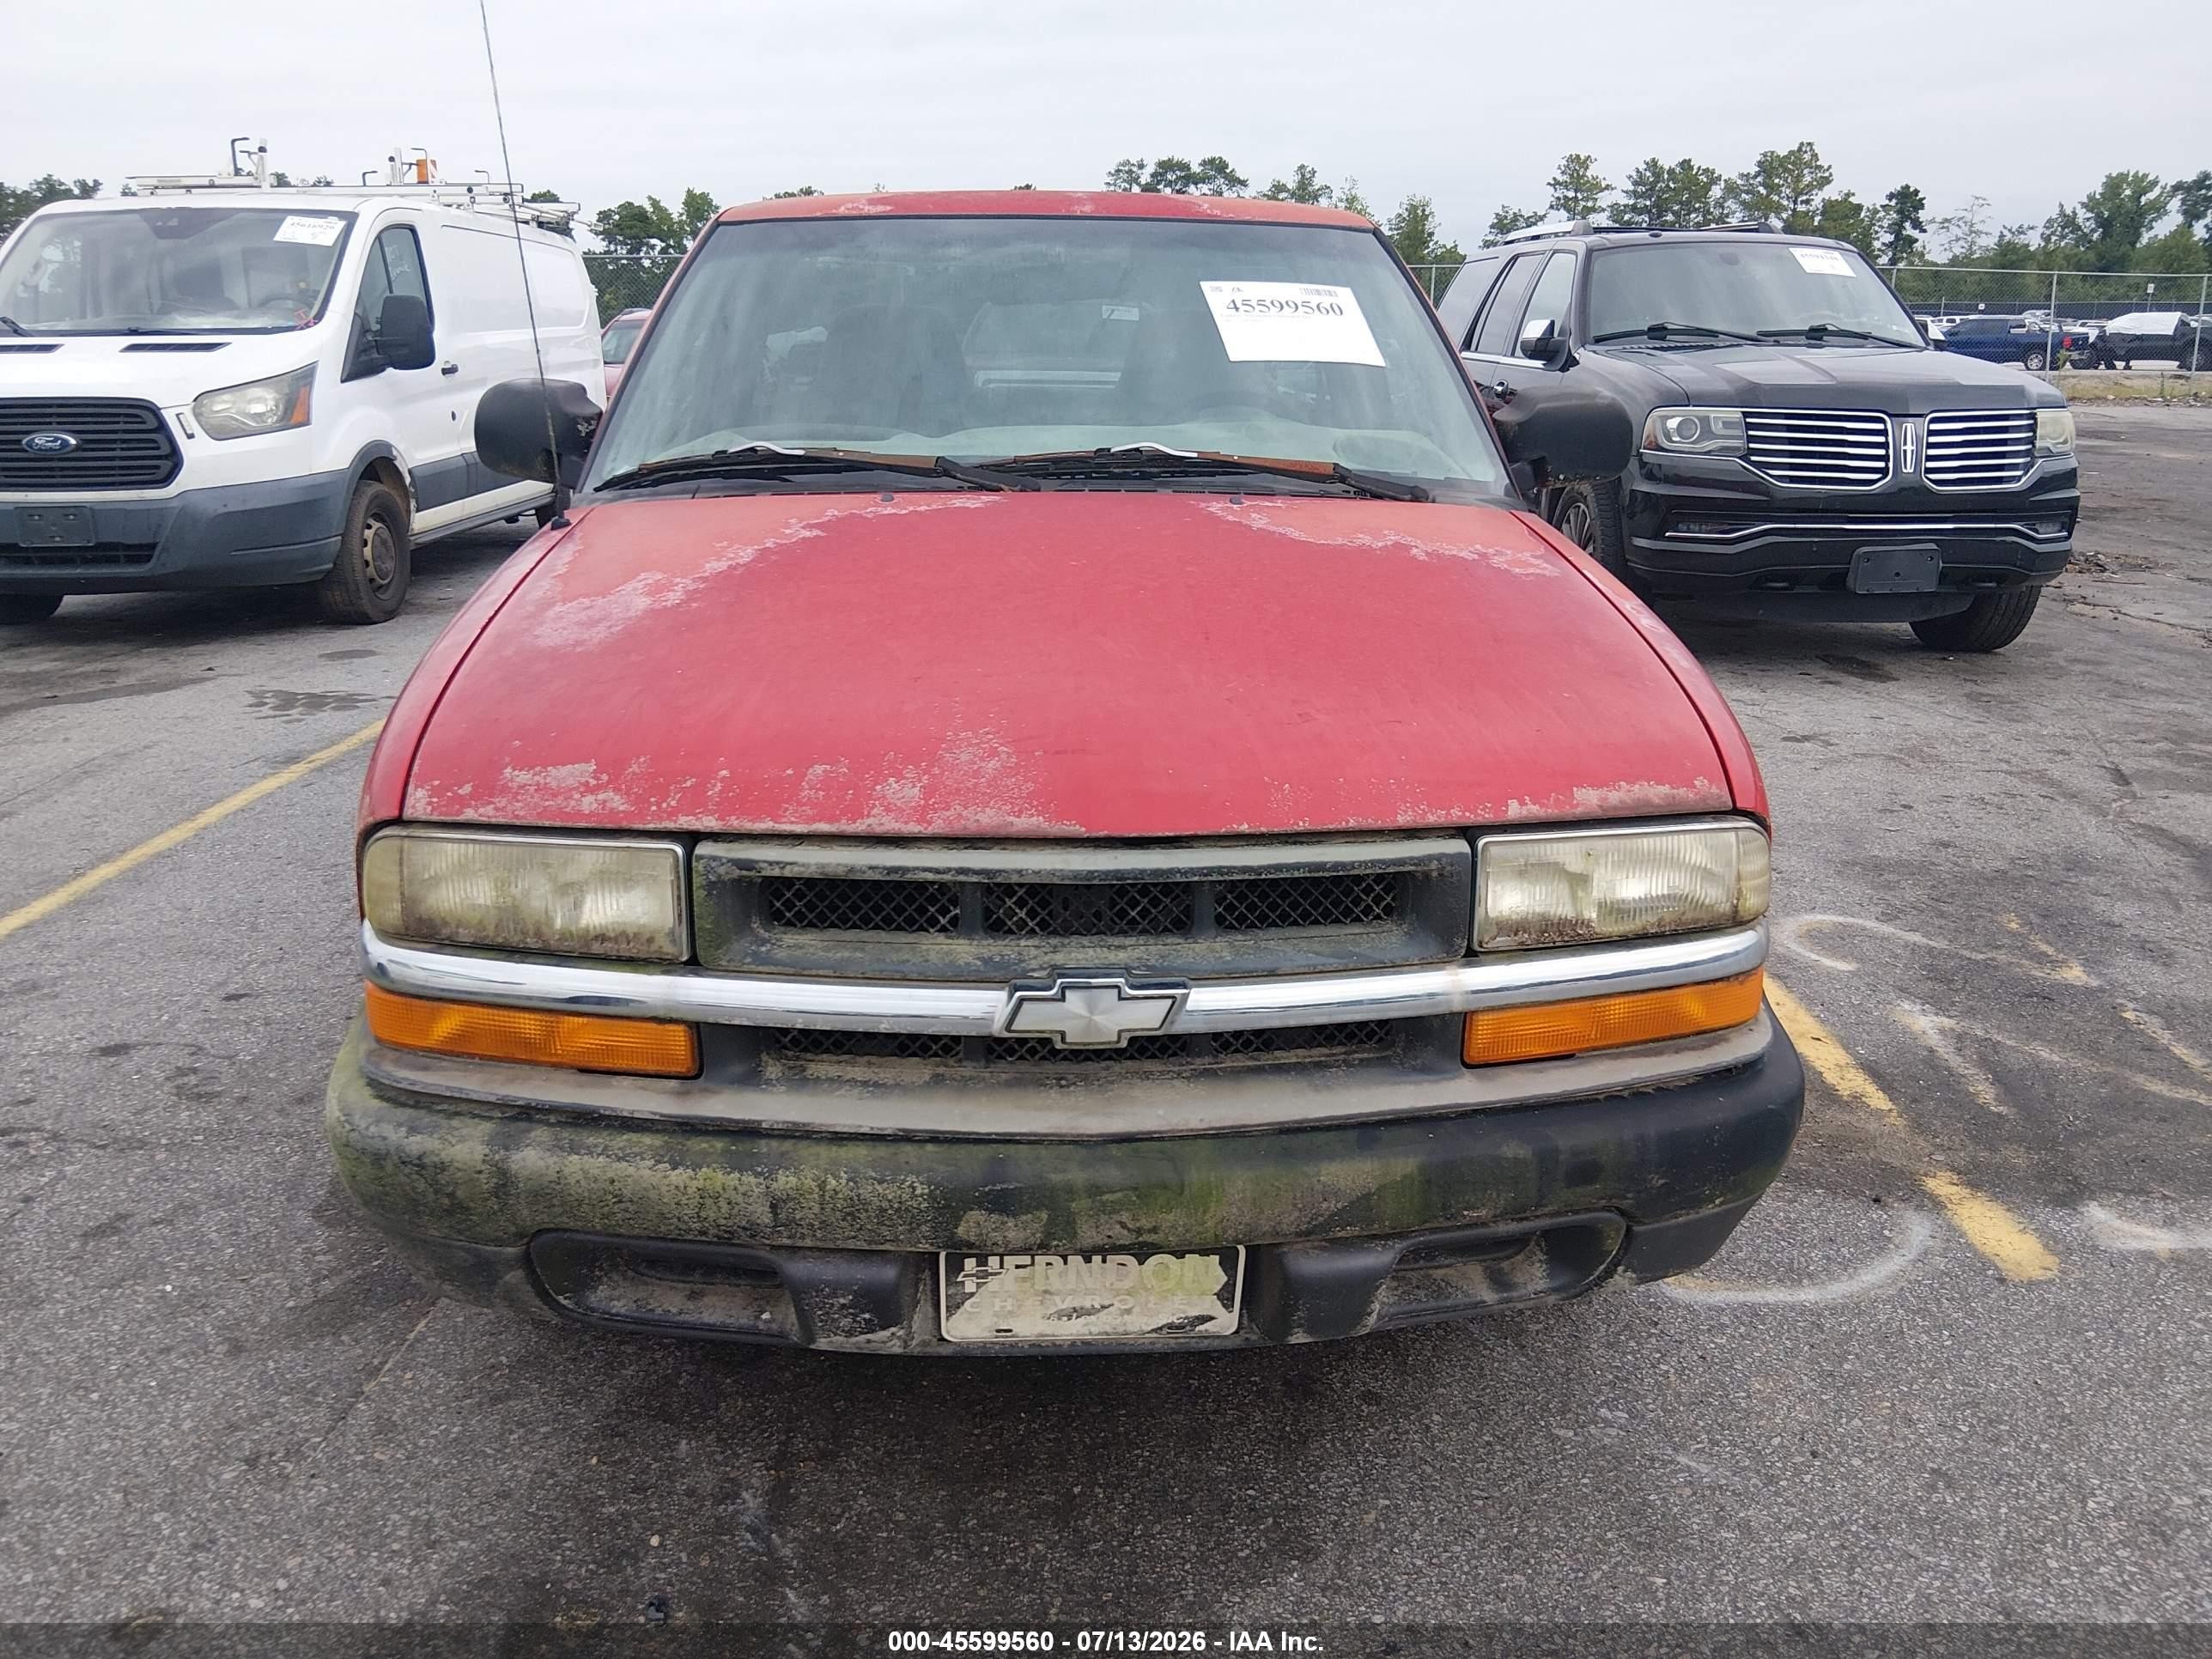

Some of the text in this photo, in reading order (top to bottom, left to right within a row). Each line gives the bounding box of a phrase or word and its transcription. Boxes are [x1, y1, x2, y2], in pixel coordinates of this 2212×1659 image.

[1226, 298, 1343, 316] 45599560
[33, 436, 62, 449] Ford
[963, 1254, 1220, 1293] HERNDON
